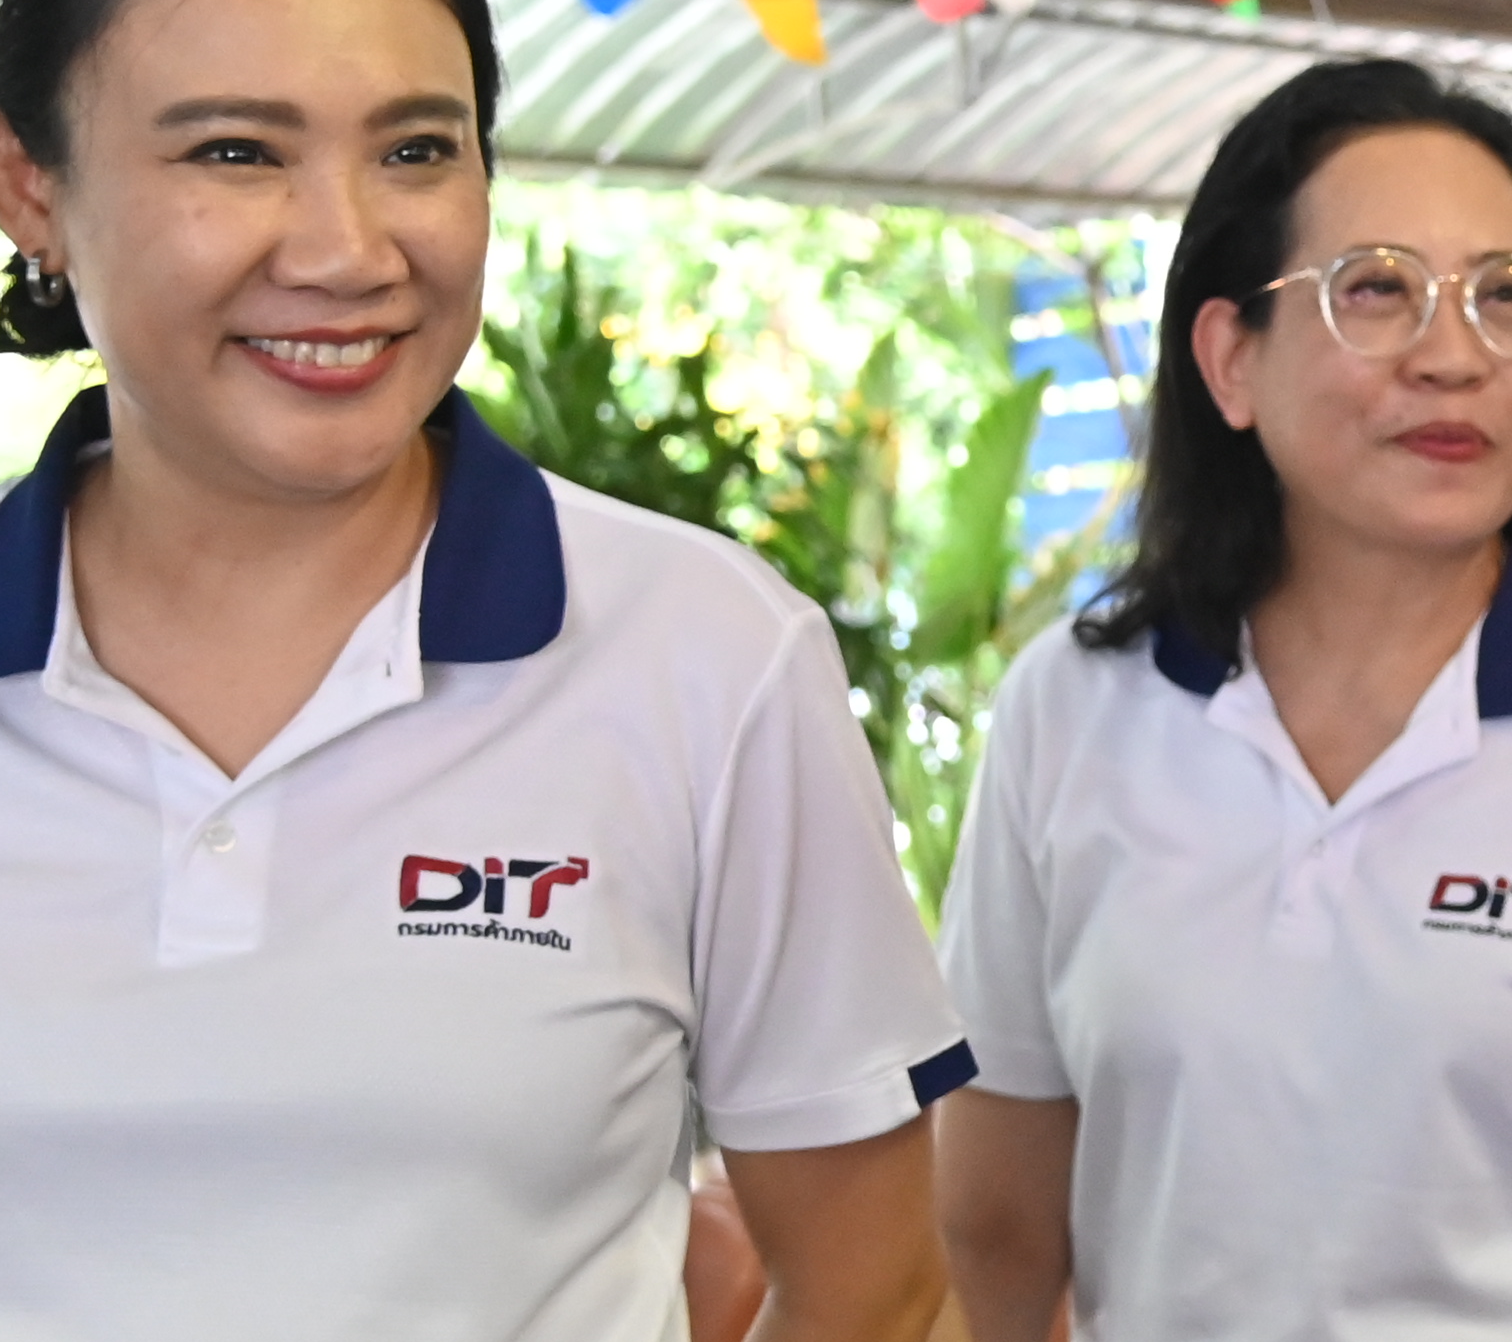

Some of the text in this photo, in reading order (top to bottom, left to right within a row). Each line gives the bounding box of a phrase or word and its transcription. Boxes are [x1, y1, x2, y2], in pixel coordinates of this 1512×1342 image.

[397, 918, 572, 952] กรมการค้าภายใน
